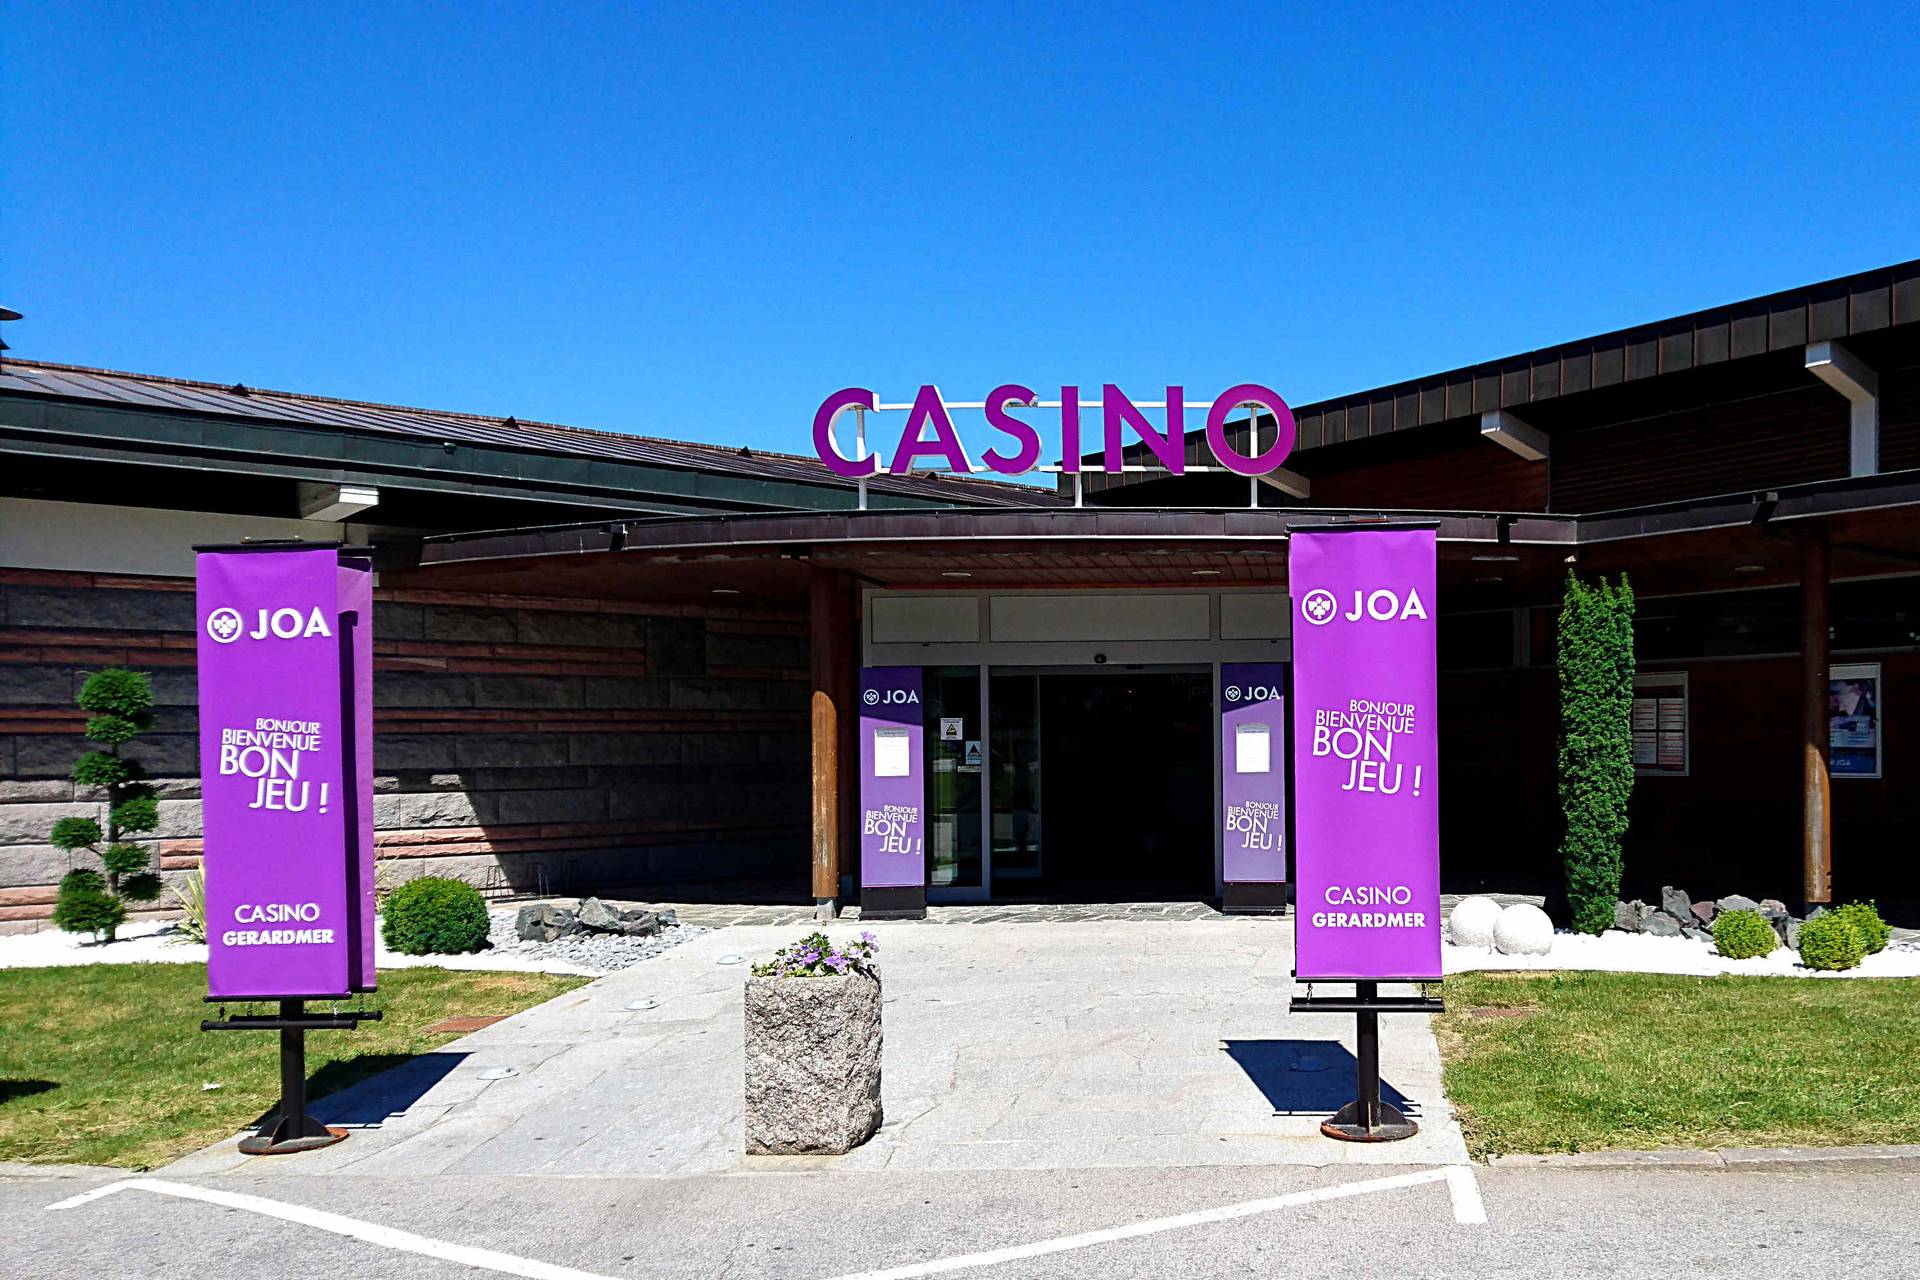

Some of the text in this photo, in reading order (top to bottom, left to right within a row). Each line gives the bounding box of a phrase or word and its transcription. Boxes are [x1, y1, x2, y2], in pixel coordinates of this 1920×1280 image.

[812, 383, 1297, 478] CASINO
[1345, 587, 1427, 621] JOA
[250, 606, 332, 640] JOA
[883, 690, 919, 703] JOA
[1244, 686, 1281, 700] JOA
[1350, 699, 1415, 717] BONJOUR
[255, 718, 321, 735] BONJOUR
[1315, 709, 1415, 734] BIENVENUE
[222, 728, 321, 752] BIENVENUE
[1312, 725, 1393, 762] BON
[219, 744, 300, 780] BON
[1341, 759, 1422, 797] JEU !
[248, 777, 330, 814] JEU !
[884, 805, 918, 814] BONJOUR
[1228, 806, 1279, 820] BIENVENUE
[1246, 801, 1279, 811] BONJOUR
[866, 810, 918, 823] BIENVENUE
[1226, 815, 1268, 834] BON
[864, 819, 907, 838] BON
[880, 836, 921, 854] JEU !
[1241, 832, 1282, 851] JEU !
[1325, 886, 1412, 905] CASINO
[234, 903, 321, 923] CASINO
[1312, 912, 1426, 928] GERARDMER
[222, 929, 334, 946] GERARDMER
